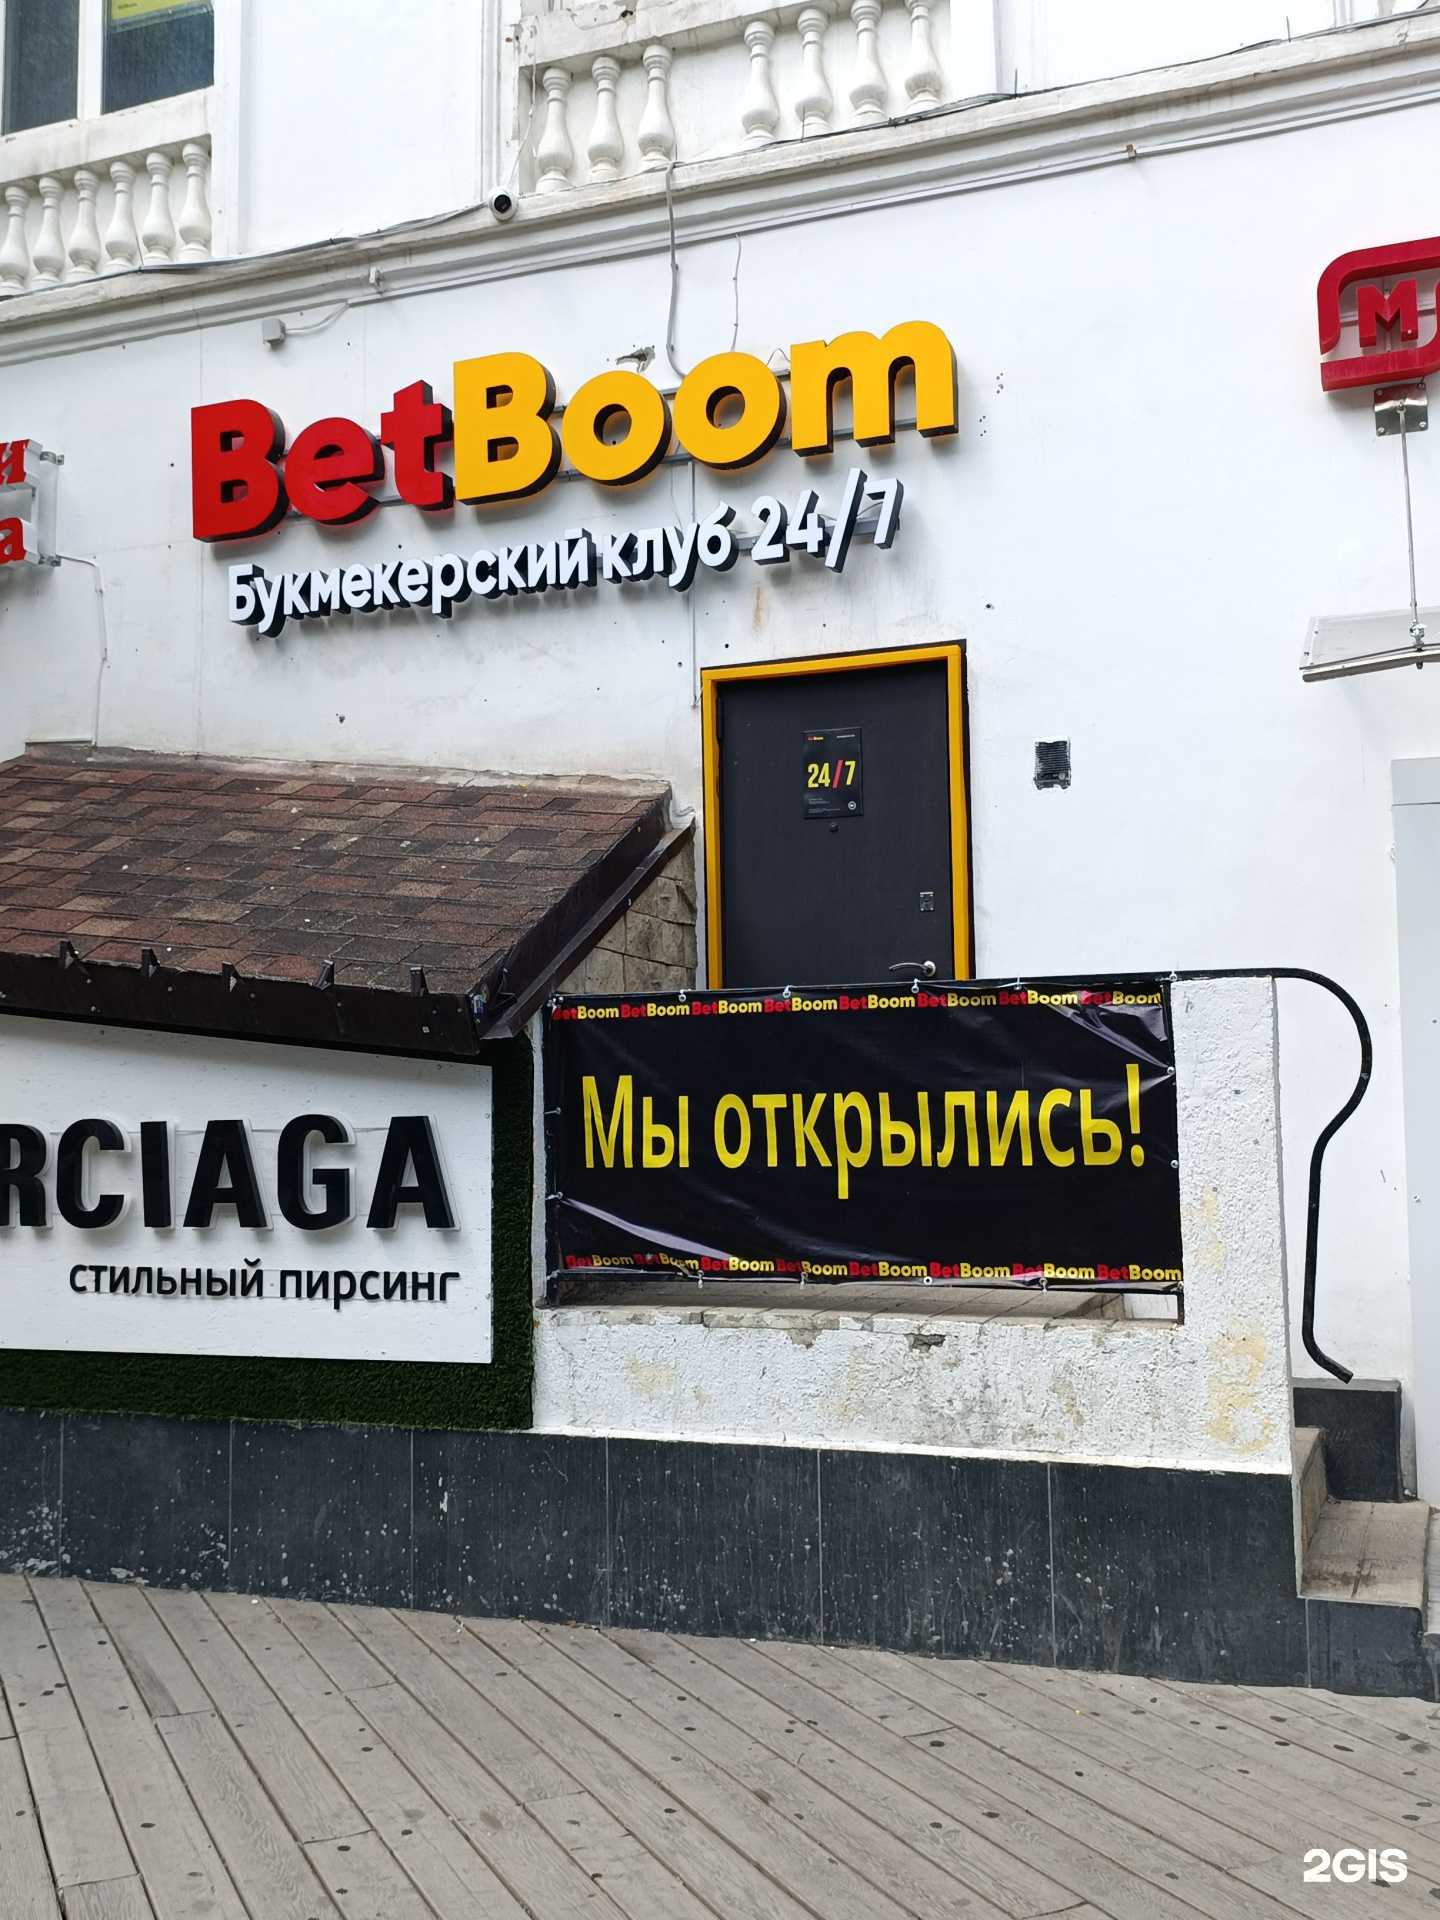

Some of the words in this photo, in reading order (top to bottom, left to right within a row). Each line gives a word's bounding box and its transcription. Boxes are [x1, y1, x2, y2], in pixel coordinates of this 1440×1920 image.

[191, 320, 958, 542] BetBoom
[228, 527, 596, 637] Букмекерский
[602, 502, 737, 592] клуб
[750, 467, 904, 573] 24/7
[807, 759, 856, 789] 24/7
[620, 1002, 690, 1019] BetBoom
[691, 999, 763, 1016] BetBoom
[764, 996, 838, 1014] BetBoom
[839, 994, 916, 1011] BetBoom
[917, 991, 997, 1007] BetBoom
[1000, 990, 1078, 1006] BetBoom
[581, 1073, 689, 1169] Мы
[713, 1063, 1145, 1200] открылись!
[68, 1257, 264, 1299] стильный
[279, 1269, 461, 1311] пирсинг
[700, 1255, 775, 1272] BetBoom
[775, 1258, 848, 1276] BetBoom
[849, 1260, 928, 1277] BetBoom
[929, 1261, 1011, 1278] BetBoom
[1097, 1263, 1183, 1281] BetBoom
